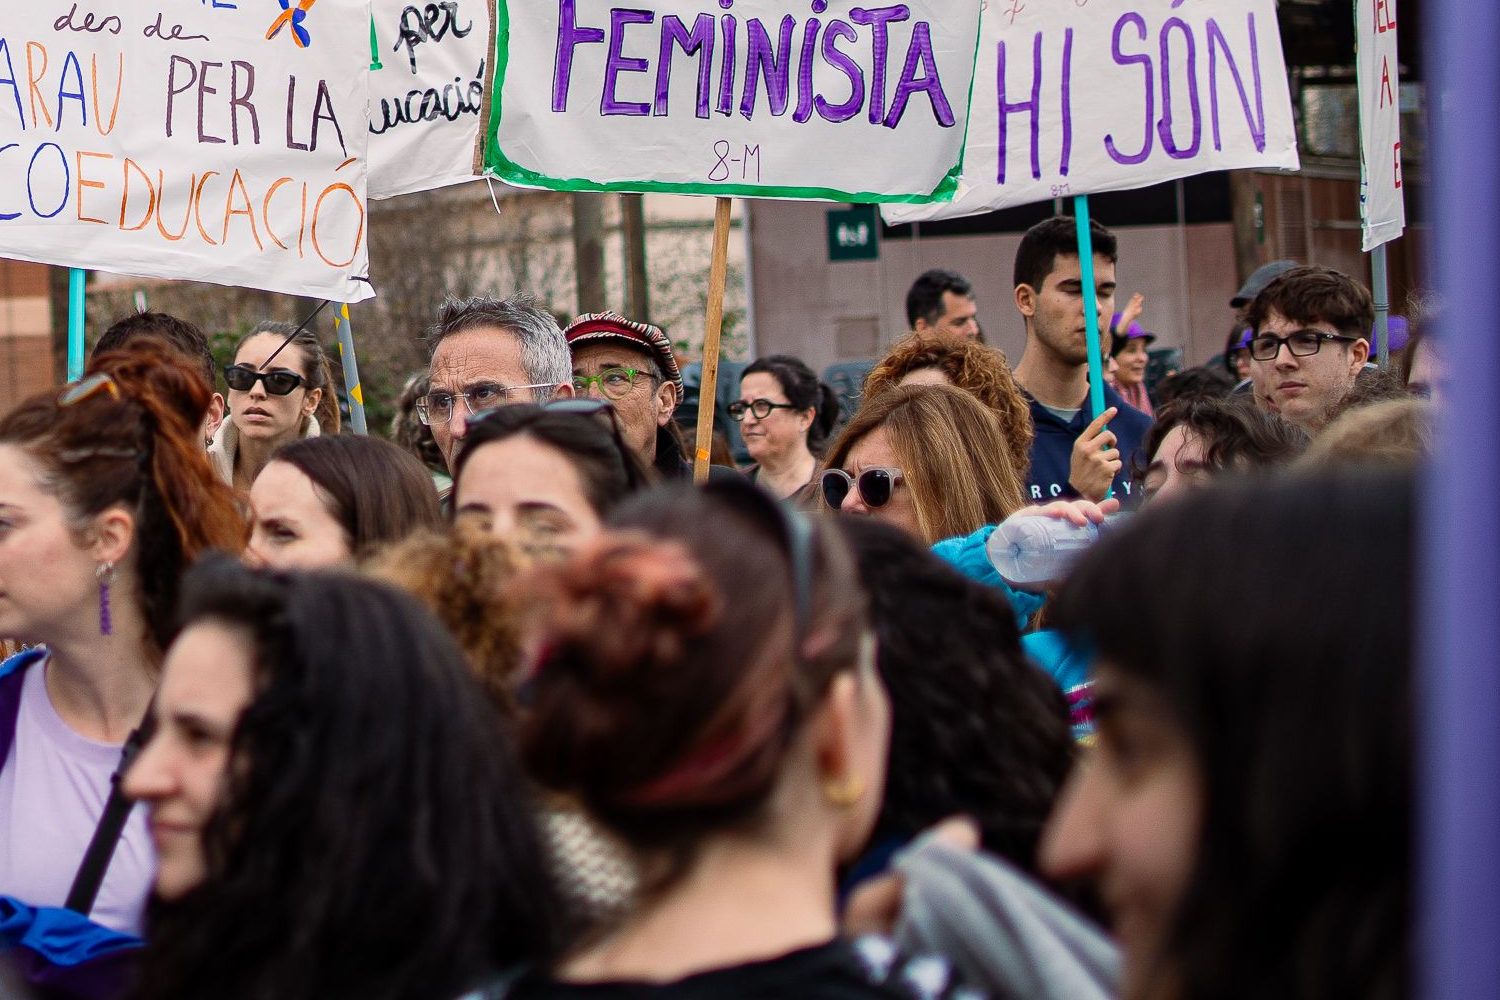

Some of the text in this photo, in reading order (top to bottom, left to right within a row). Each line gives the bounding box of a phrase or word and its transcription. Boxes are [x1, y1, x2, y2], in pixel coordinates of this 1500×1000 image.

[53, 2, 211, 42] des de
[393, 1, 473, 75] per
[166, 54, 261, 146] PER
[286, 74, 349, 158] LA
[997, 26, 1074, 185] HI
[708, 139, 761, 183] 8-M
